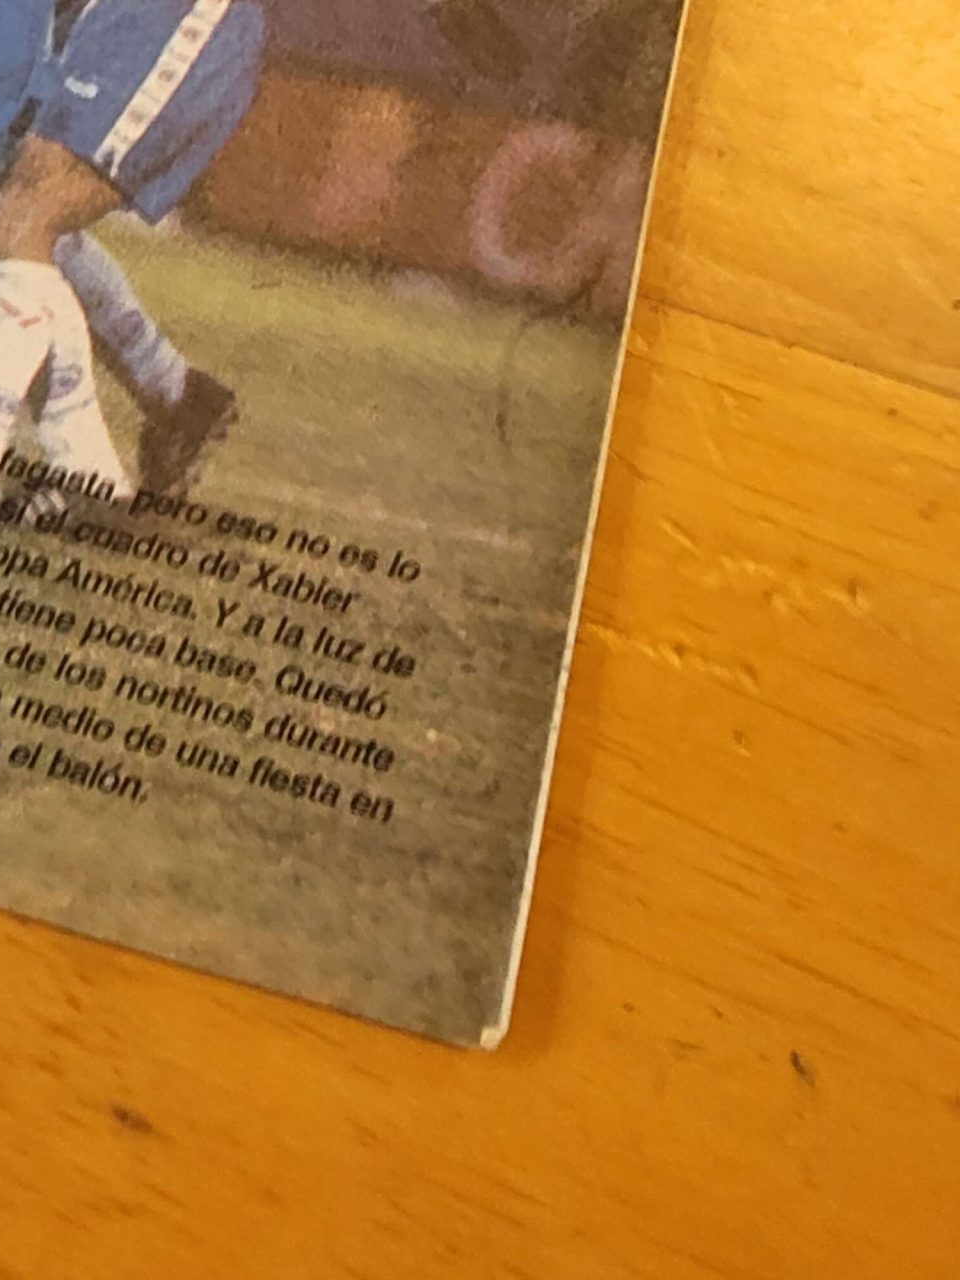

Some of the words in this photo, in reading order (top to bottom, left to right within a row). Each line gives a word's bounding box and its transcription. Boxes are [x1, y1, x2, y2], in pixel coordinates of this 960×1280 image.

[34, 506, 68, 536] el
[75, 519, 189, 569] cuadro
[197, 549, 240, 583] de
[248, 560, 357, 614] Xabier
[128, 488, 208, 526] pero
[216, 511, 279, 545] eso
[285, 528, 330, 560] no
[338, 542, 379, 573] es
[386, 549, 421, 585] lo
[54, 557, 198, 621] América.
[216, 597, 240, 629] Y
[241, 613, 265, 638] a
[272, 615, 304, 649] la
[312, 626, 366, 664] luz
[371, 645, 416, 679] de
[79, 616, 167, 659] poca
[173, 637, 265, 689] base.
[274, 664, 390, 721] Quedó
[4, 641, 47, 674] de
[53, 653, 107, 693] los
[114, 672, 256, 735] nortinos
[264, 713, 396, 773] durante
[9, 693, 115, 744] medio
[123, 724, 168, 758] de
[176, 740, 240, 779] una
[248, 754, 342, 809] fiesta
[349, 789, 395, 825] en
[8, 742, 43, 771] el
[46, 748, 149, 805] balón.
